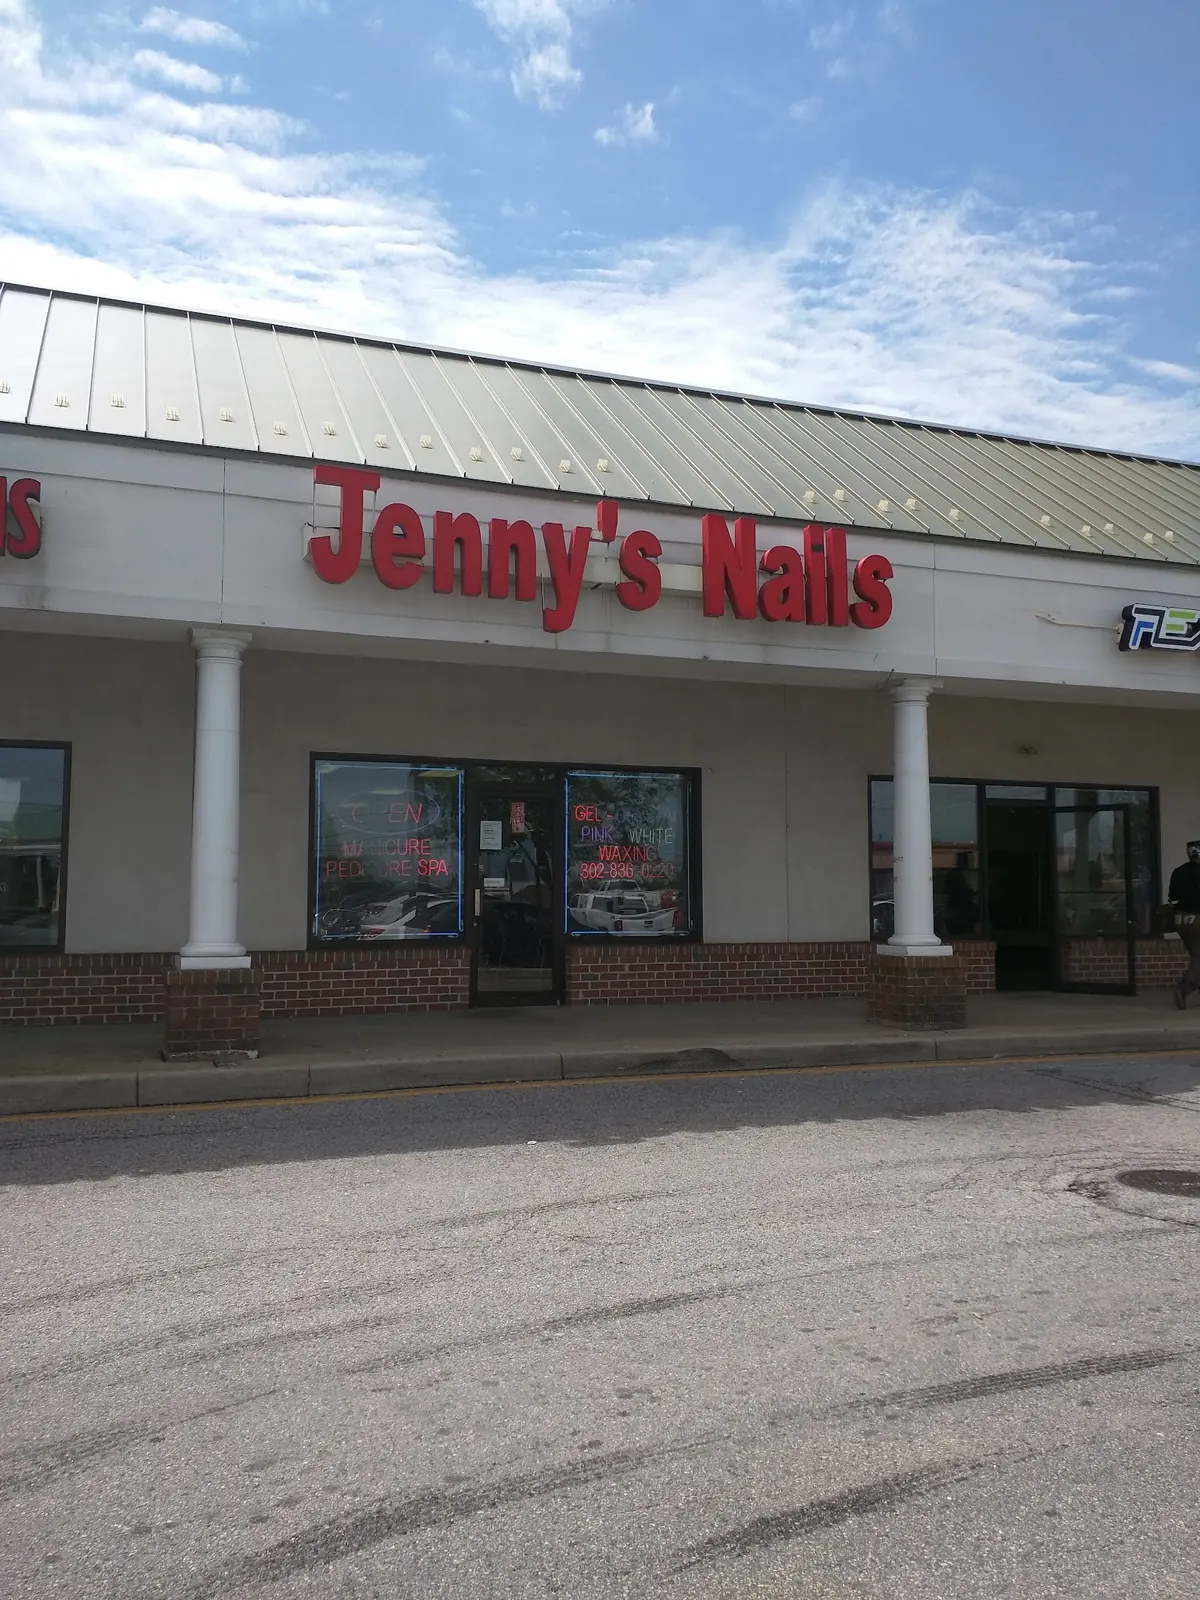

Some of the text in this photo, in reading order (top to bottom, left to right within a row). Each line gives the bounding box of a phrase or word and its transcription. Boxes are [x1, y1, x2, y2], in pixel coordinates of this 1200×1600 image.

[309, 464, 893, 633] Jenny's Nails
[352, 803, 423, 824] OEN
[574, 805, 602, 821] GEL
[581, 827, 673, 844] PINK WHITE
[342, 838, 431, 857] MAICURE
[599, 845, 658, 862] WAXING
[417, 859, 449, 877] SPA
